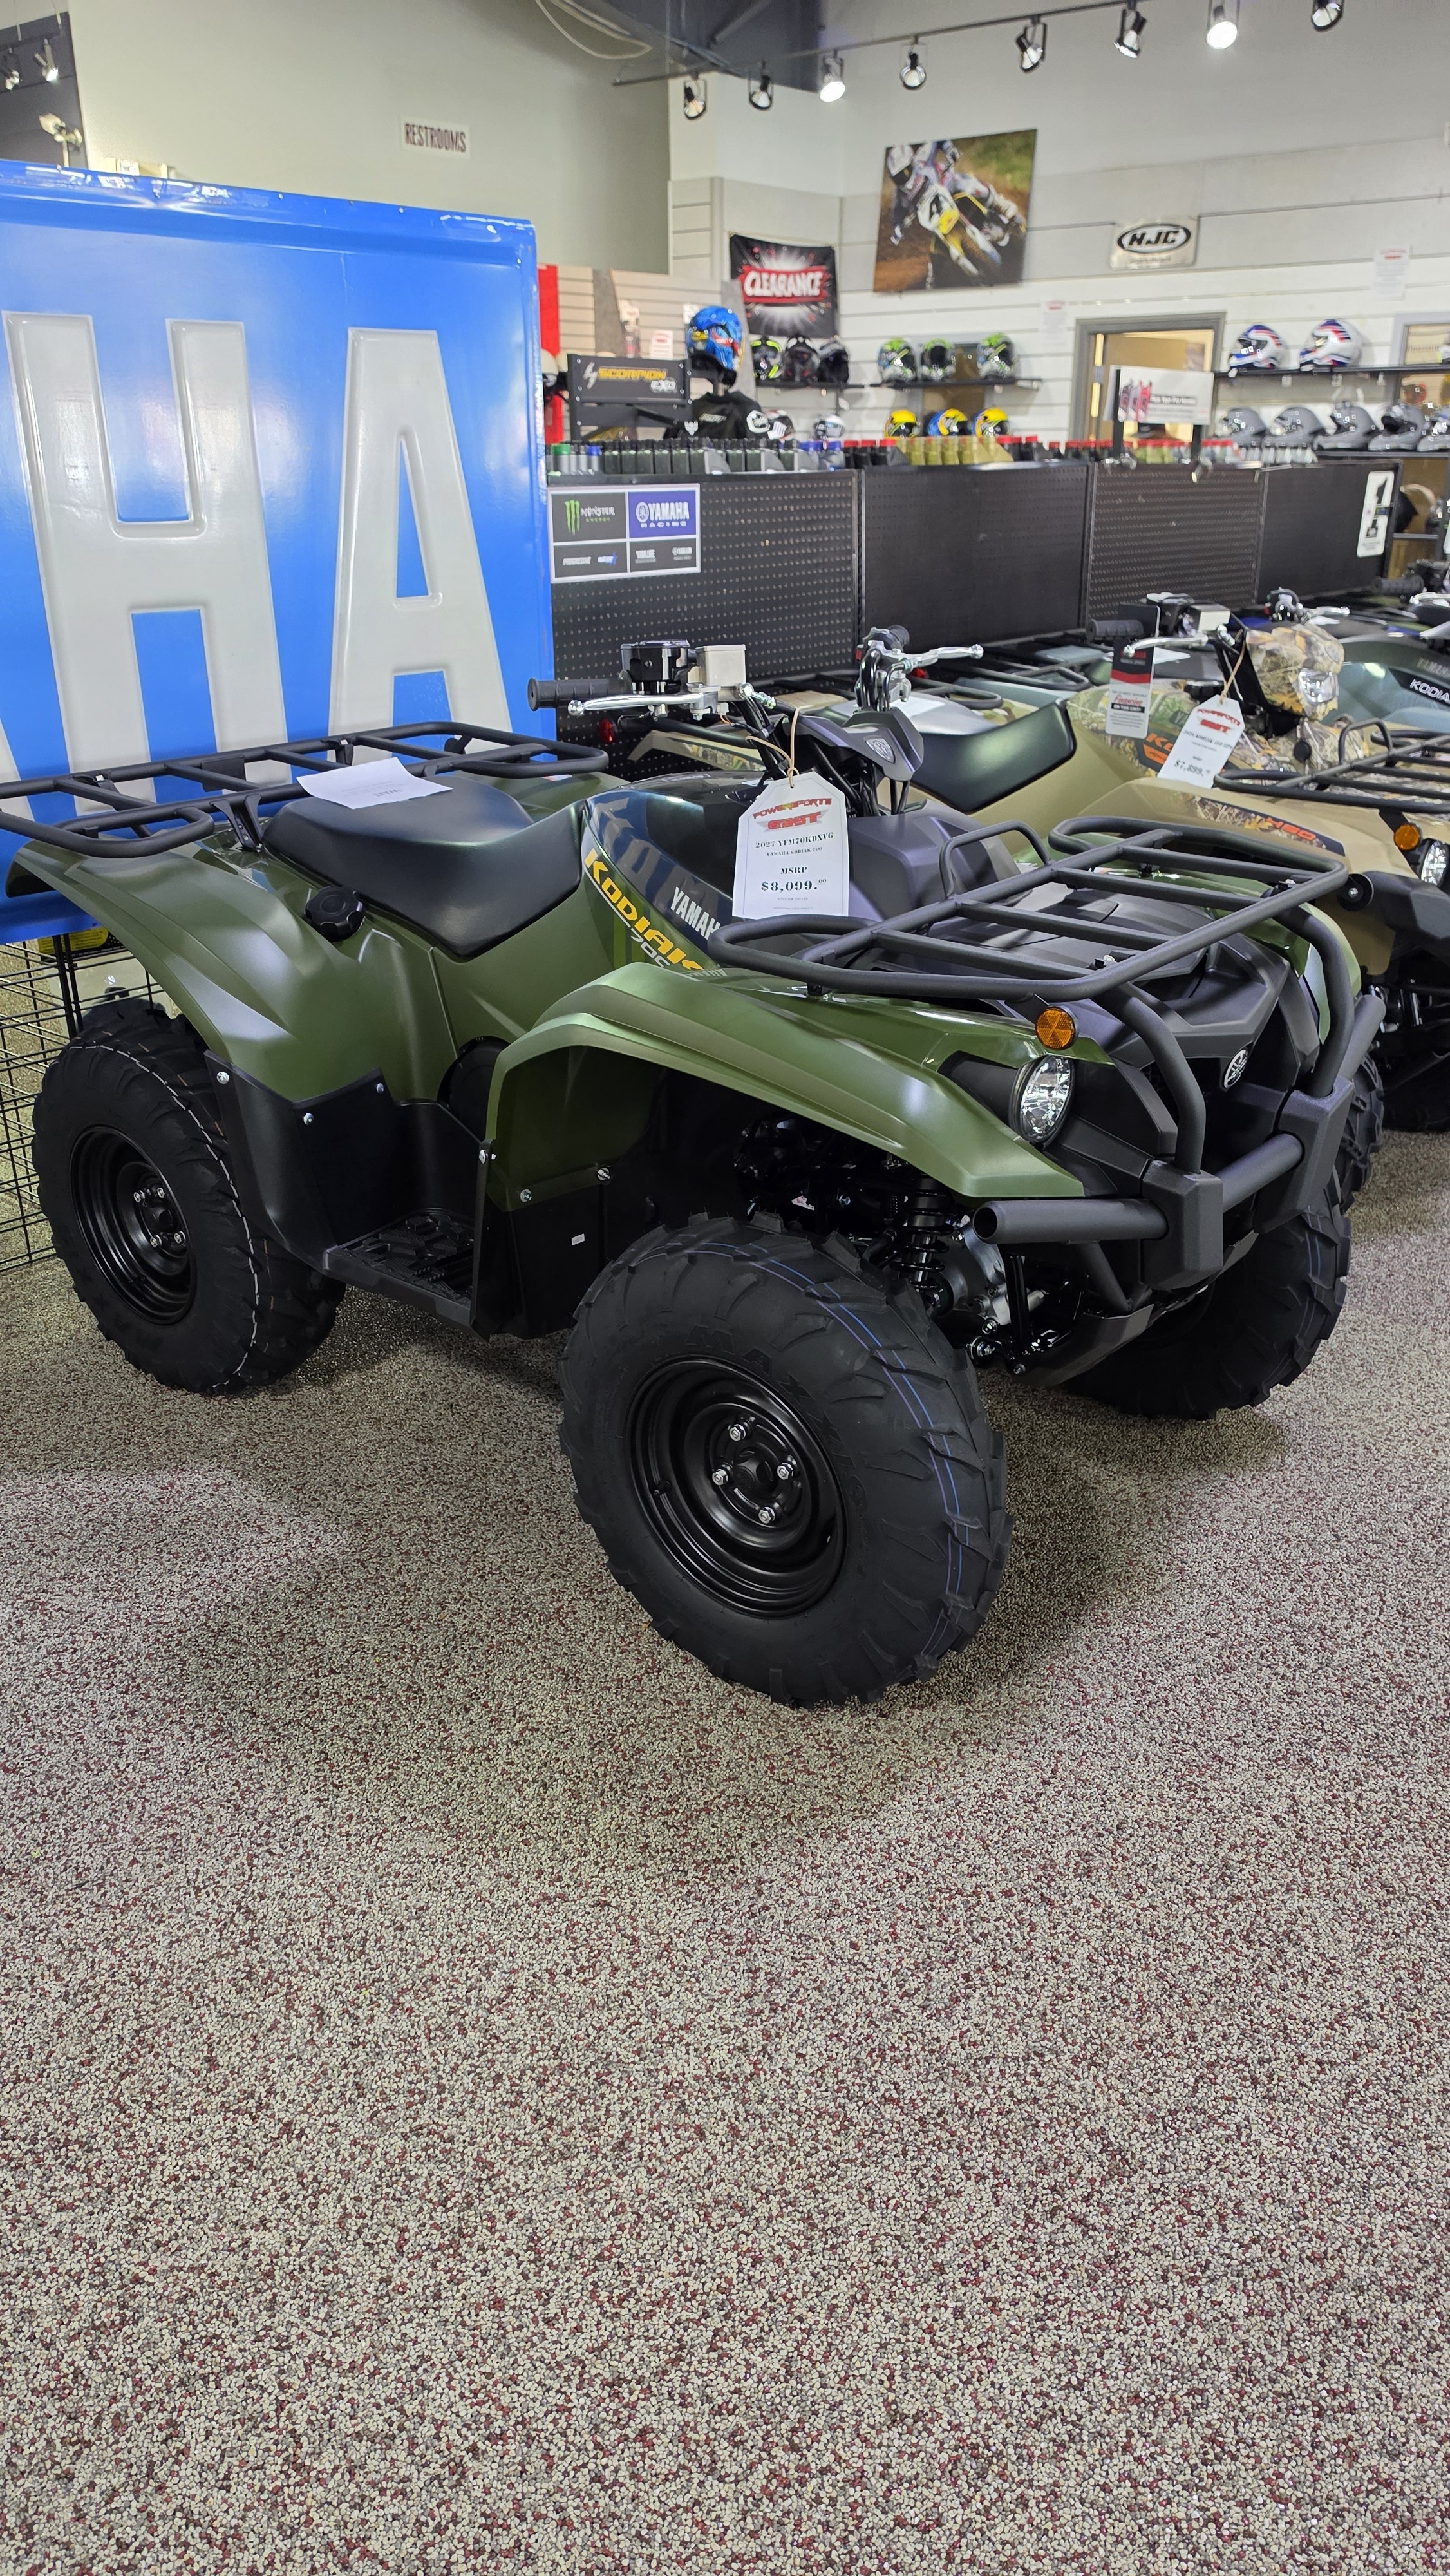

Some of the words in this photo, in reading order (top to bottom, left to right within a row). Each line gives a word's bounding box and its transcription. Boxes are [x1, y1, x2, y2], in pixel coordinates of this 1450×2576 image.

[404, 122, 466, 153] RESTROOMS
[1128, 230, 1180, 246] HJC
[744, 270, 823, 297] CLEARANCE
[598, 368, 666, 380] SCORPION
[581, 506, 615, 517] MONSTER
[648, 502, 690, 521] YAMAHA
[0, 311, 516, 819] HA
[1409, 678, 1450, 703] KODIA
[753, 798, 832, 819] POWERSPORTS
[1266, 817, 1316, 841] 450
[584, 848, 704, 971] KODIAK
[670, 887, 720, 940] YAMAH
